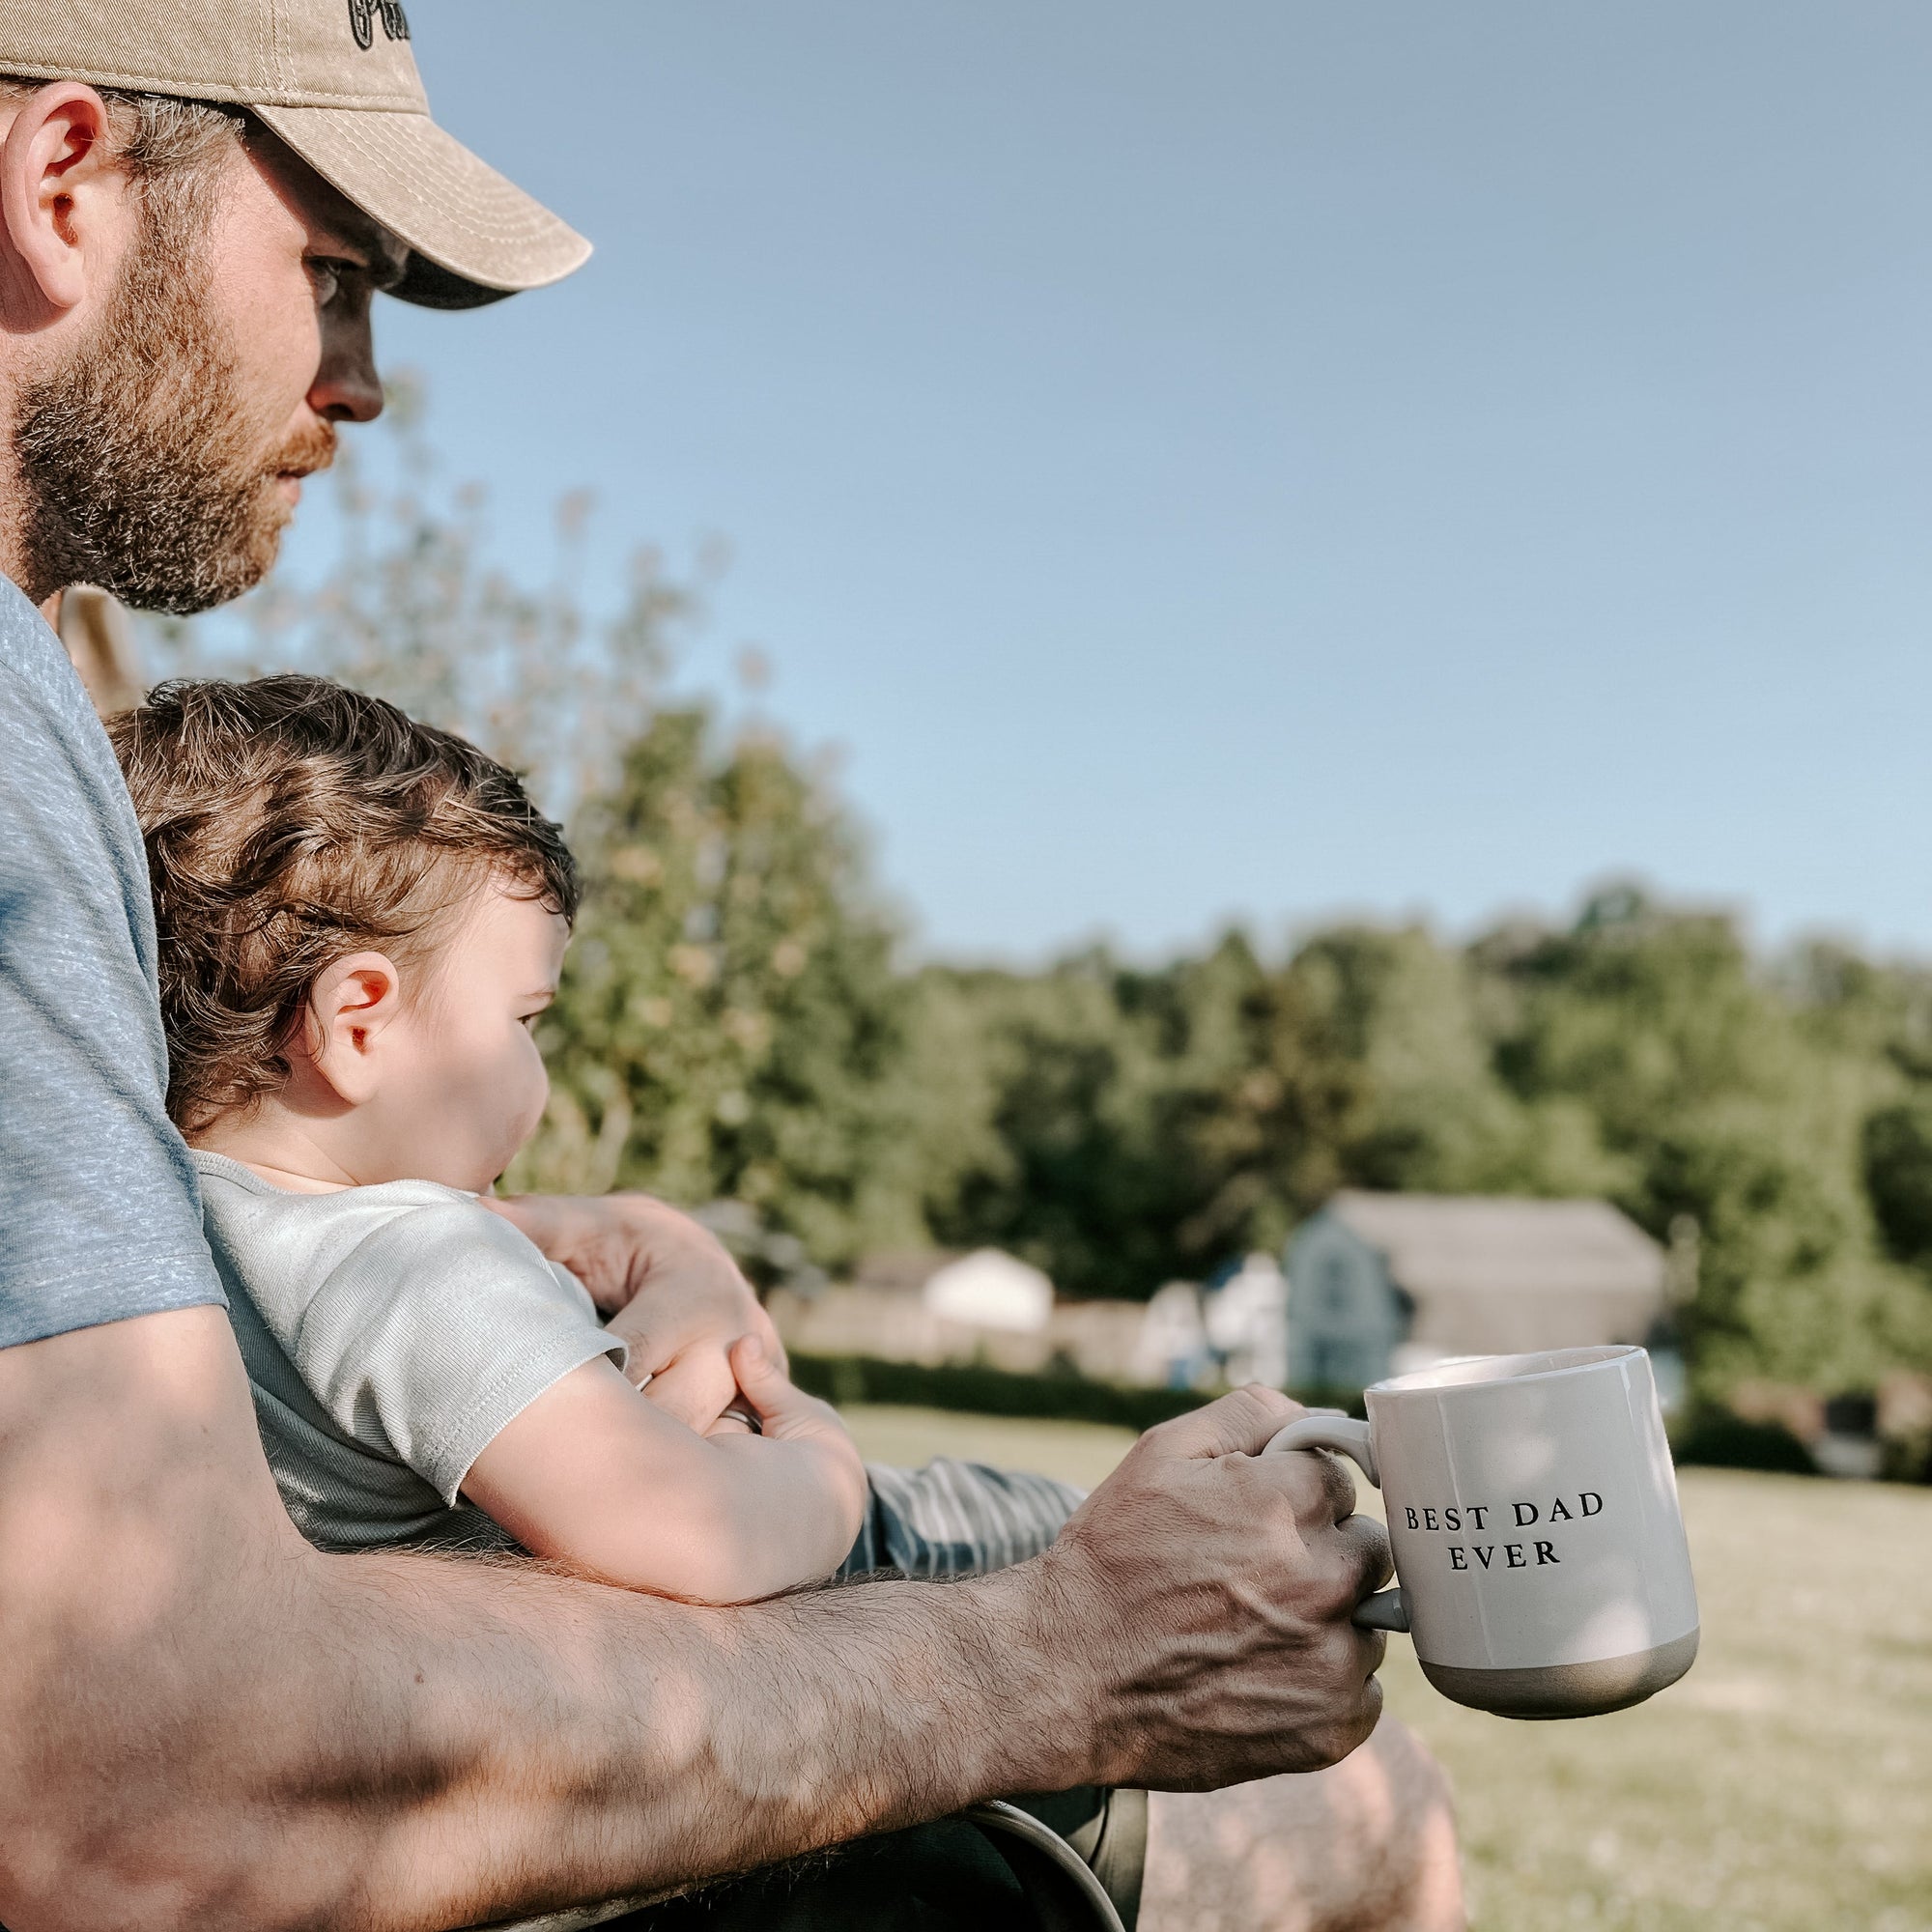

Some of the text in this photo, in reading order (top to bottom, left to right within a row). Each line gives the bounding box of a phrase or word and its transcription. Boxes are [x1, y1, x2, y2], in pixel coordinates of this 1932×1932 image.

[1405, 1492, 1604, 1531] BEST DAD
[1448, 1541, 1560, 1571] EVER
